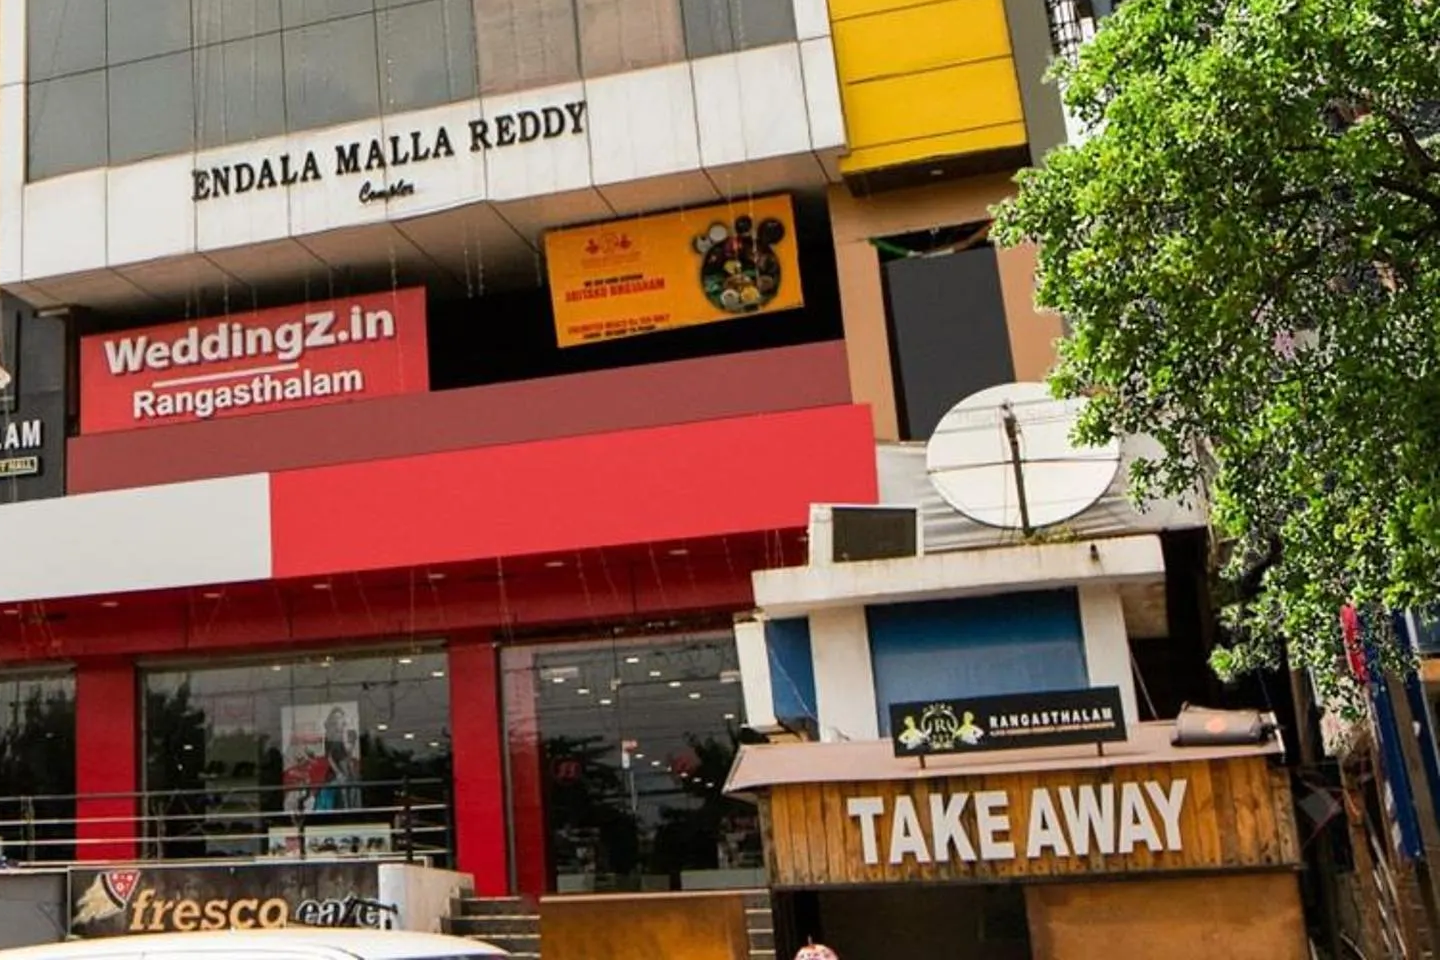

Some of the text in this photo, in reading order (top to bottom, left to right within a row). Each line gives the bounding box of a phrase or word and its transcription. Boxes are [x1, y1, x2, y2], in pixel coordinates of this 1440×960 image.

[191, 100, 587, 201] ENDALA MALLA REDDY
[133, 368, 364, 419] Rangasthalam
[989, 707, 1113, 729] RANGASTHALAM
[846, 779, 1187, 865] TAKE AWAY
[129, 889, 289, 932] fresco
